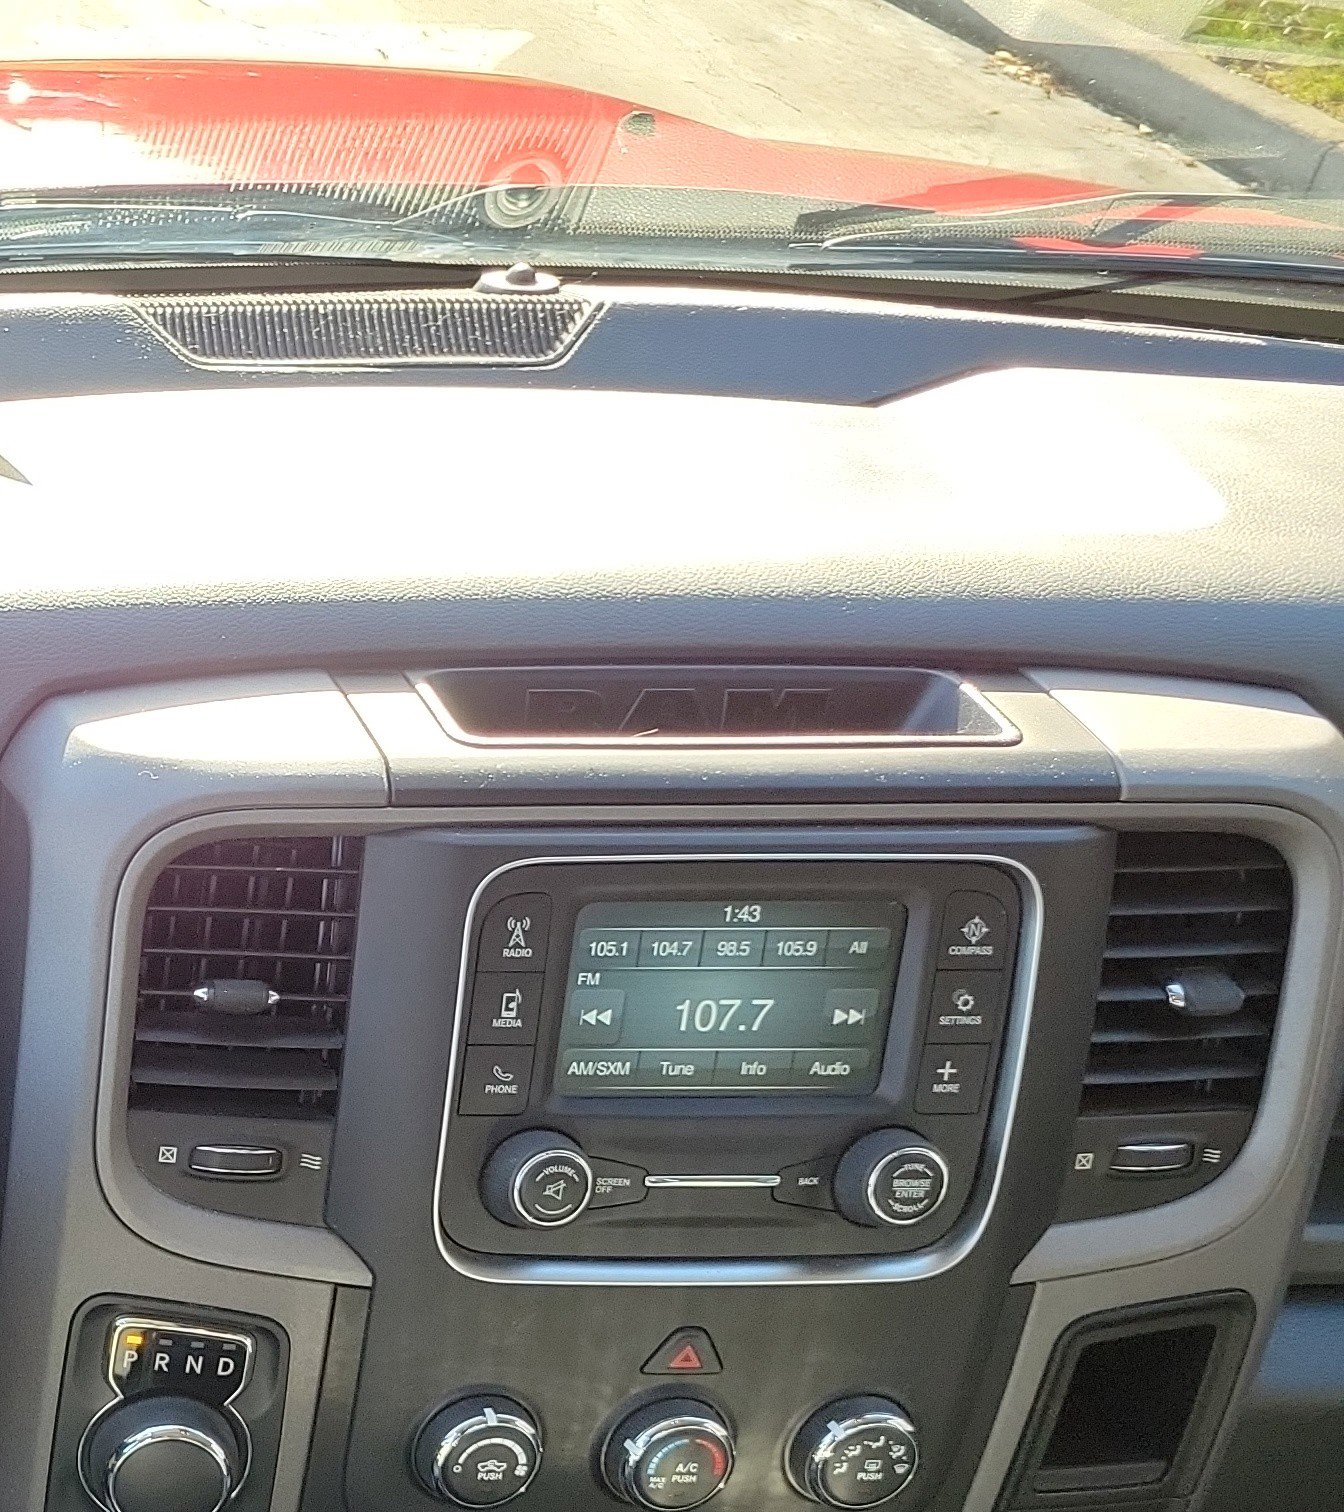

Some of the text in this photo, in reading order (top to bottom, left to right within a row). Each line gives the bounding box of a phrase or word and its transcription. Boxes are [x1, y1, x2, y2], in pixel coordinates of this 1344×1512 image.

[723, 905, 761, 923] 1:43
[502, 948, 532, 958] RADIO
[589, 941, 629, 957] 105.1
[651, 941, 693, 957] 104.7
[717, 941, 750, 957] 98.5
[777, 941, 817, 957] 105.9
[948, 946, 993, 955] COMPASS
[577, 973, 600, 986] FM
[676, 999, 774, 1032] 107.7
[492, 1018, 522, 1027] MEDIA
[939, 1016, 982, 1025] SETTINGS
[567, 1061, 850, 1076] AM/SXM Tune Info Audio
[485, 1084, 518, 1094] PHONE
[932, 1084, 960, 1093] MORE
[543, 1165, 576, 1177] VOLUME
[596, 1177, 631, 1186] SCREEN
[798, 1177, 819, 1185] BACK
[892, 1178, 932, 1187] BROWSE
[895, 1190, 925, 1198] ENTER
[122, 1352, 234, 1376] P R N D
[675, 1461, 699, 1473] A/C
[477, 1472, 503, 1481] PUSH
[672, 1474, 697, 1483] PUSH
[857, 1472, 883, 1480] PUSH
